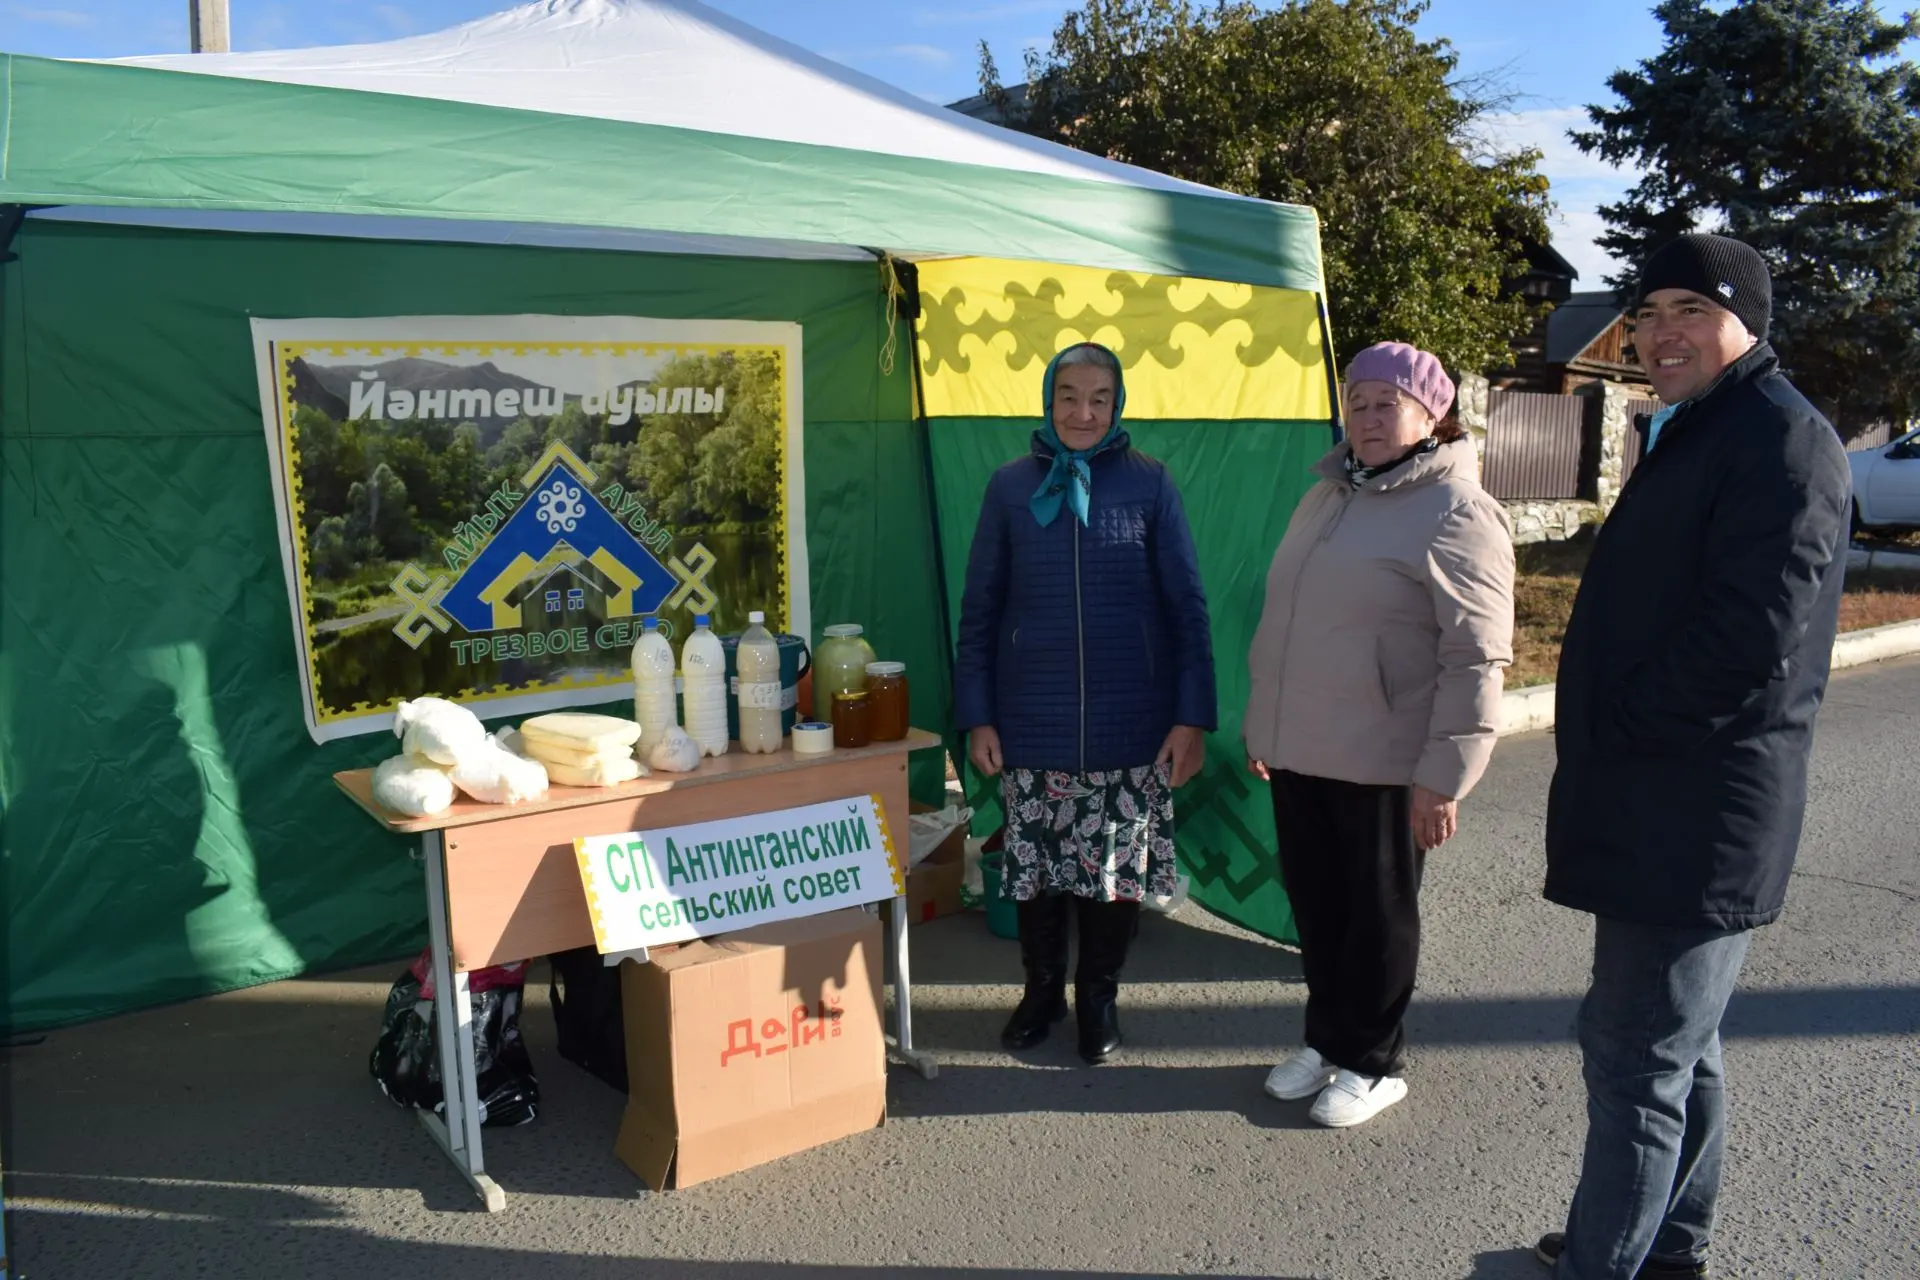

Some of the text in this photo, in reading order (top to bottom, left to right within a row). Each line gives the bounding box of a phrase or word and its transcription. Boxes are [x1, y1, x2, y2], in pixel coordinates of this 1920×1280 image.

[349, 371, 725, 426] Йәнтеш ауылы
[600, 483, 673, 554] АУЫЛ
[450, 627, 589, 665] ТРЕЗВОЕ
[606, 804, 871, 892] СП Антинганский
[638, 865, 862, 930] сельский совет
